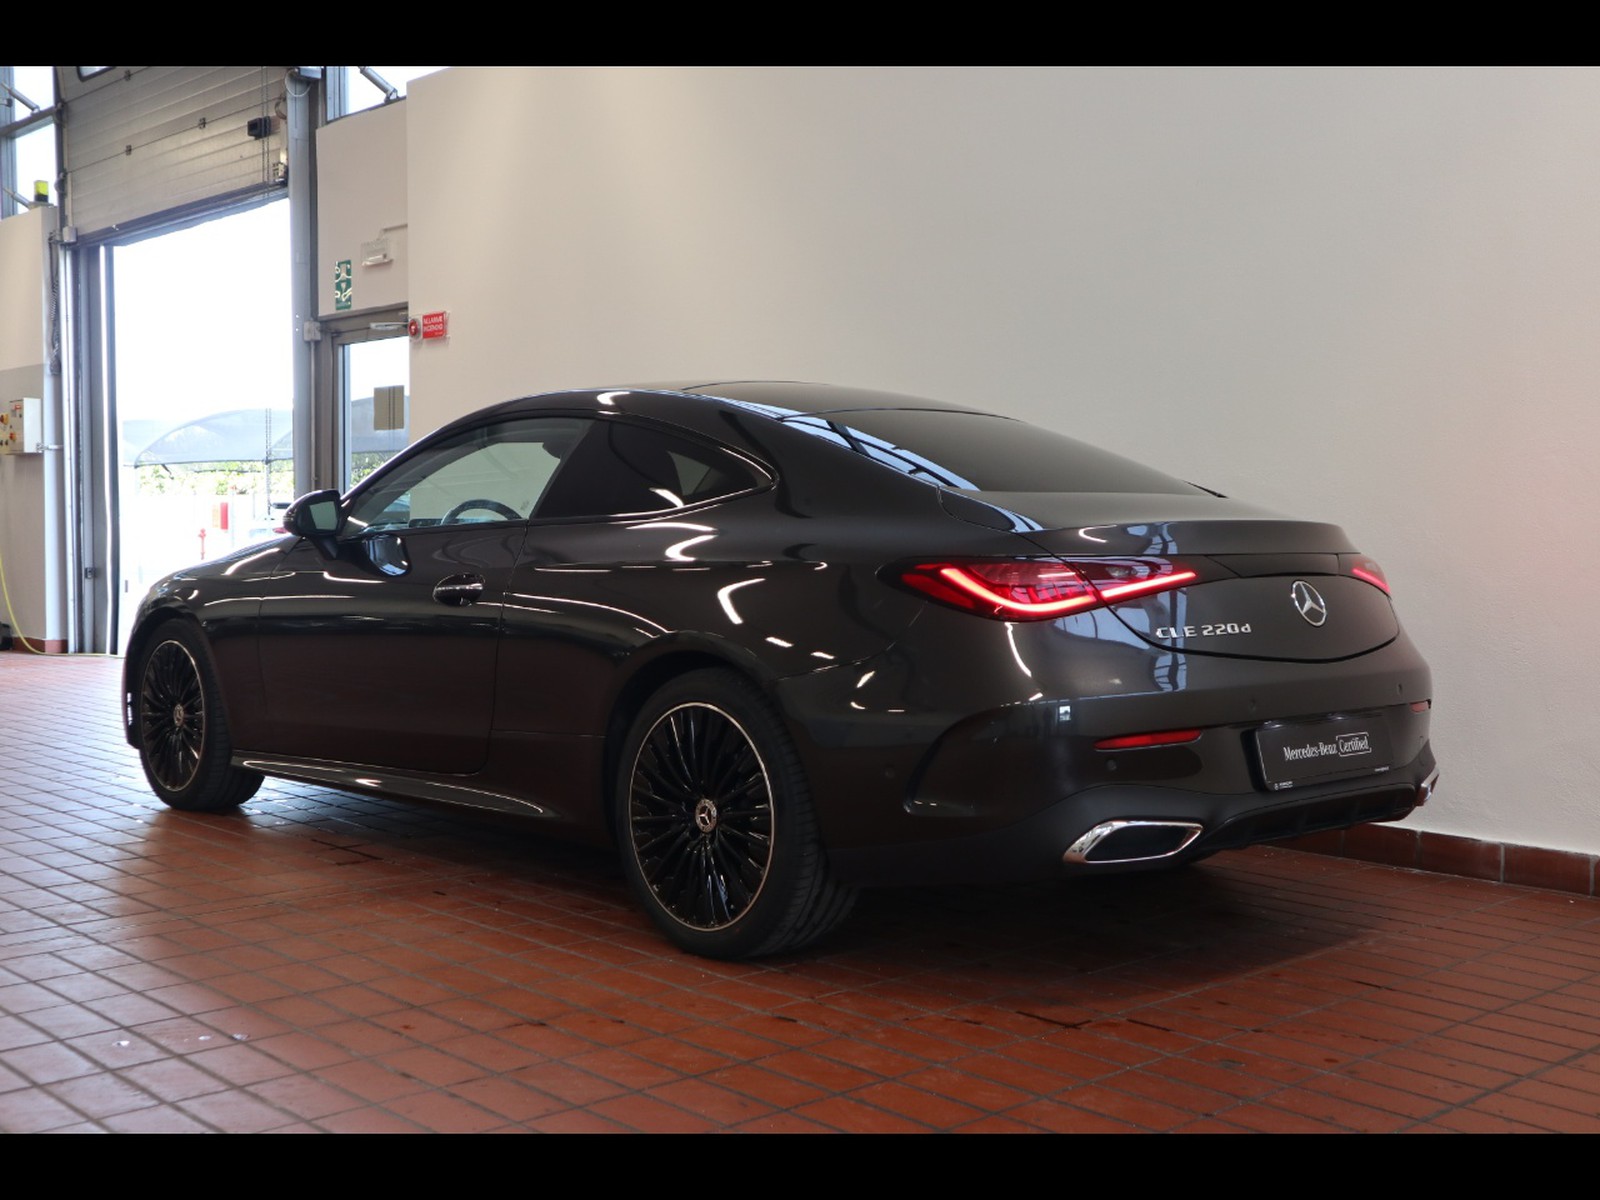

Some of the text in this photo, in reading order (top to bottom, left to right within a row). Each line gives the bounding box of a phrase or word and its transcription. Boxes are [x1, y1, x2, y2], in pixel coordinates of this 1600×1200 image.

[1156, 622, 1251, 639] CLE 220d
[1283, 736, 1369, 760] Mercedes-Benz Certified
